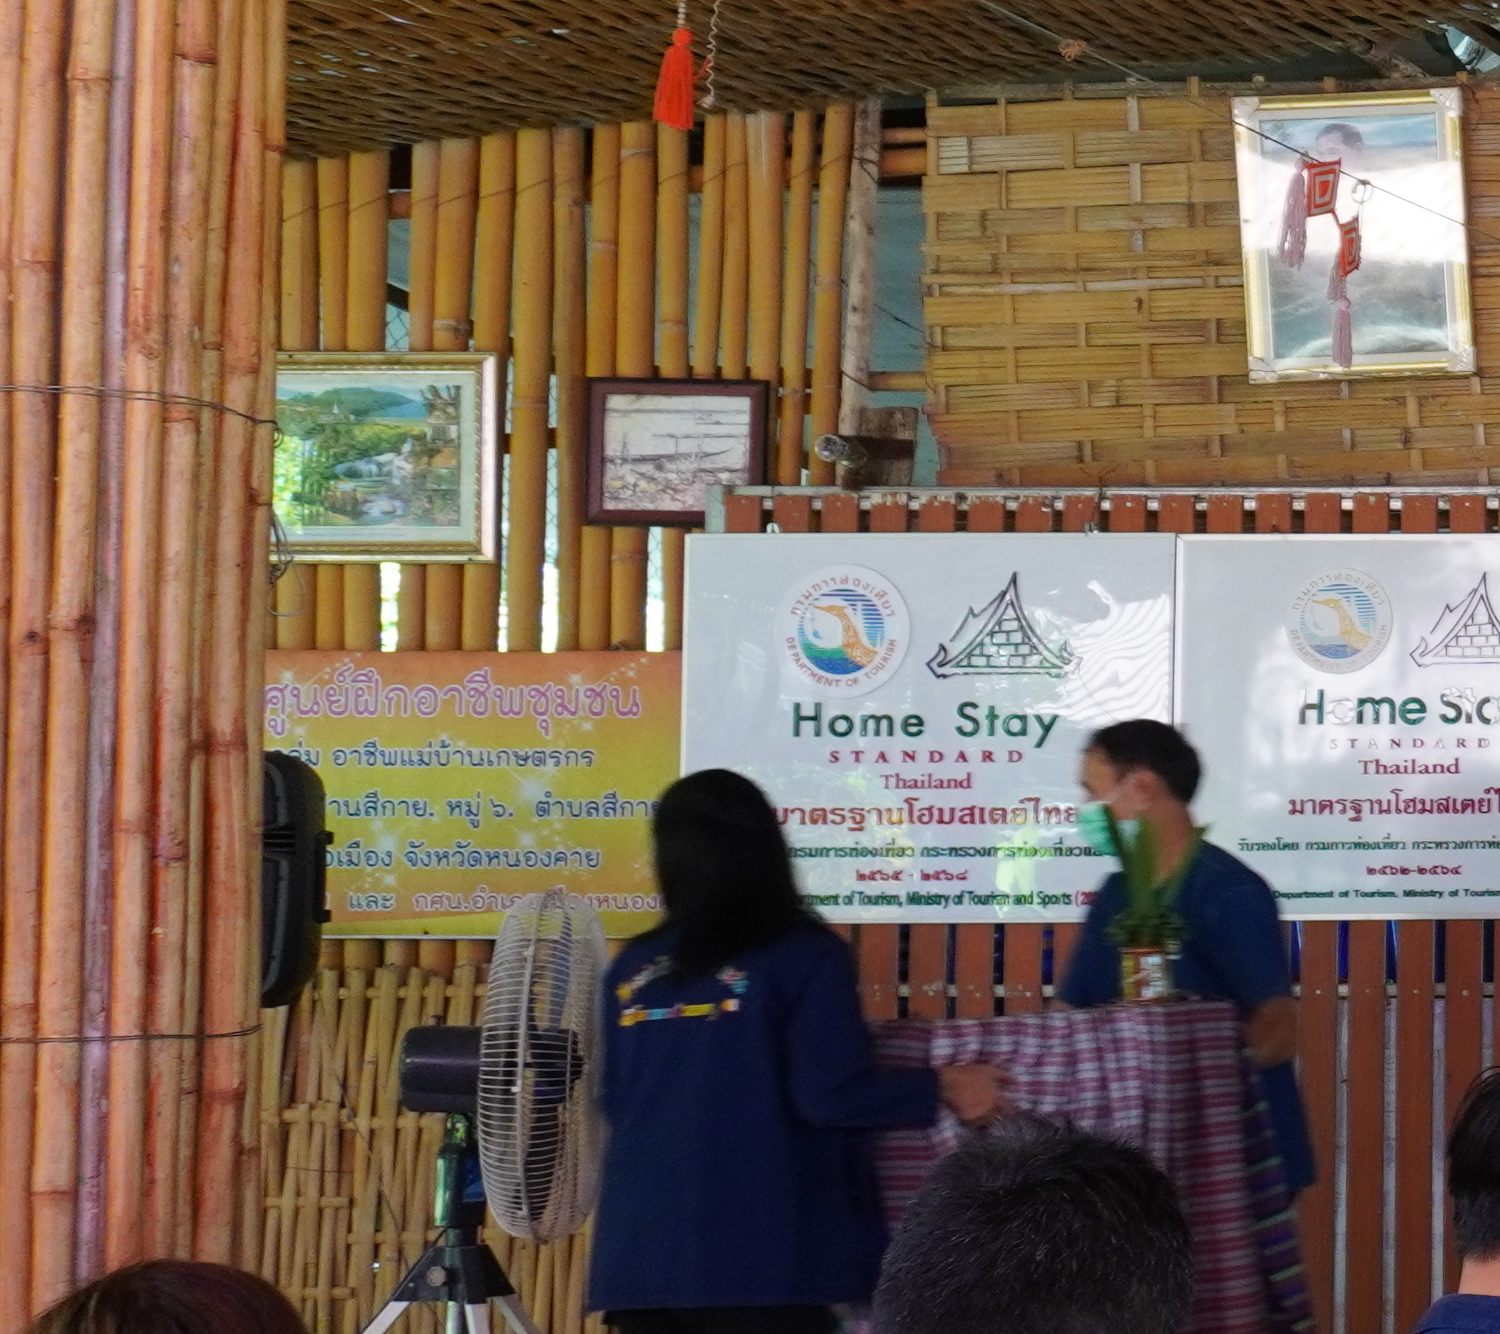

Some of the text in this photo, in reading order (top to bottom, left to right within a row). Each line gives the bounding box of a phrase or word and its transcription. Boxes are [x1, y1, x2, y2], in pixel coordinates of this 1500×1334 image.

[786, 636, 897, 687] DEPARTMENT OF TOURISM
[264, 665, 642, 737] ศูนย์ฝึกอาชีพชุมชน
[1299, 688, 1427, 727] Home
[792, 701, 1060, 748] Home Stay
[333, 739, 596, 768] อาชีพแม่บ้านเกษตรกร
[1329, 738, 1491, 749] STANDARD
[829, 750, 1025, 764] STANDARD
[1359, 758, 1461, 775] Thailand
[880, 771, 974, 791] Thailand
[326, 790, 436, 819] านสีกาย.
[404, 841, 601, 869] จังหวัดหนองคาย
[349, 892, 395, 911] และ
[906, 891, 950, 909] Ministry
[1013, 891, 1034, 906] and
[1273, 889, 1335, 900] Department
[1338, 889, 1349, 898] of
[1403, 888, 1445, 900] Ministry
[1448, 888, 1459, 898] of
